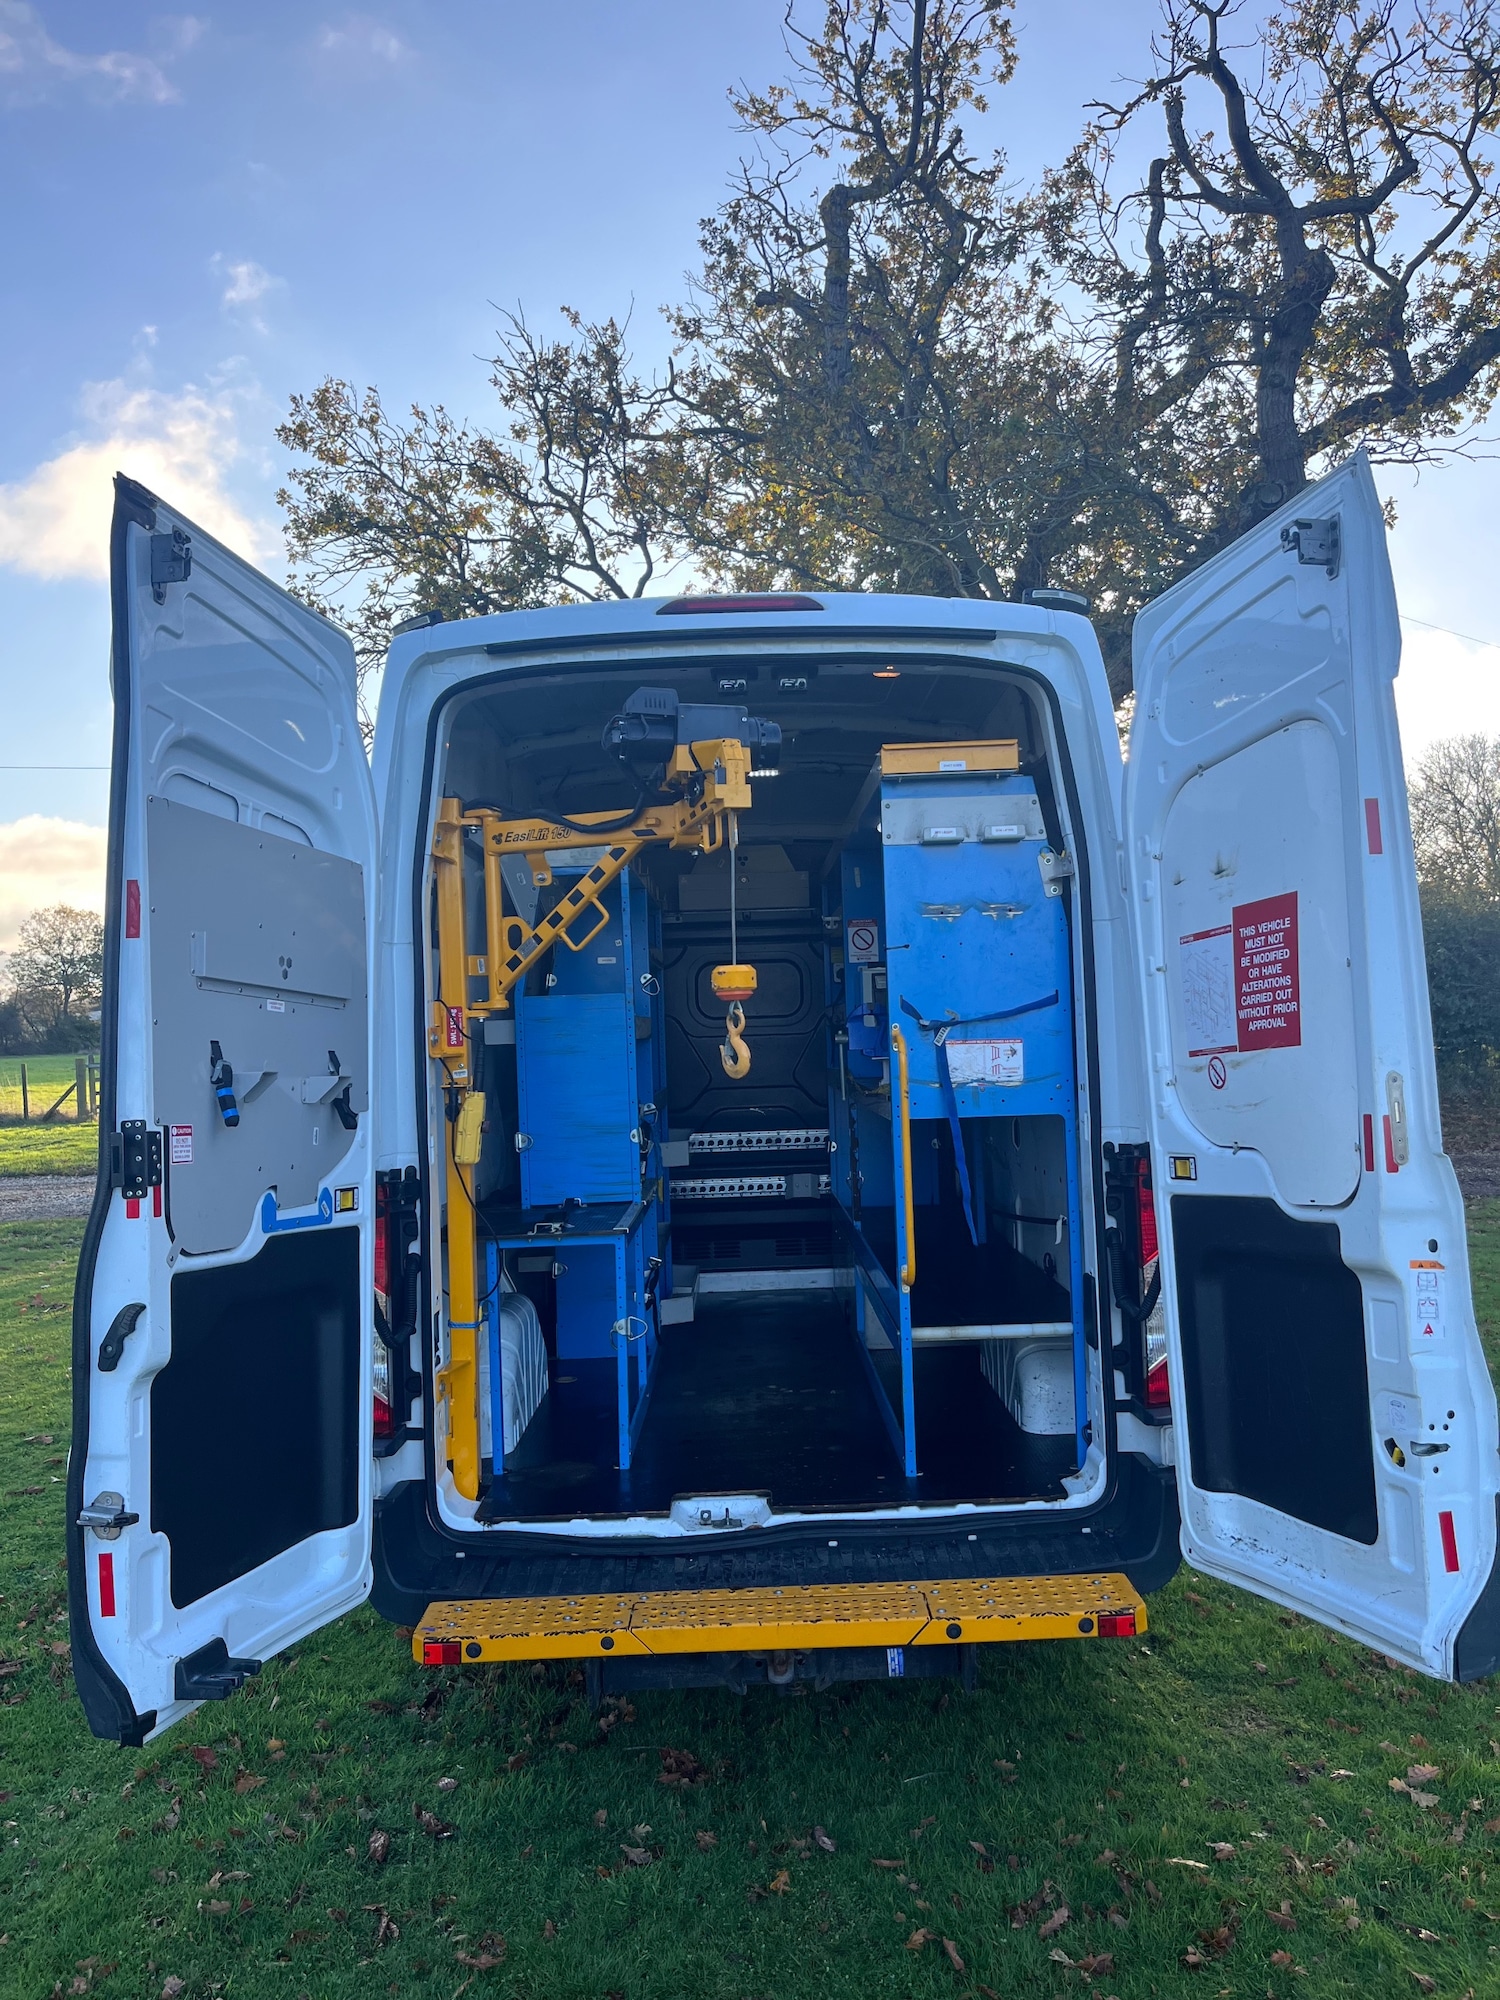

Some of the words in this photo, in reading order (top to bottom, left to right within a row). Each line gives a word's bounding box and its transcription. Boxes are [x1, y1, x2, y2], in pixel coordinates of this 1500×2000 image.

[504, 827, 550, 843] EasiLift
[551, 826, 572, 840] 150
[1239, 925, 1256, 938] THIS
[1257, 917, 1291, 933] VEHICLE
[1244, 936, 1266, 950] MUST
[1267, 932, 1284, 945] NOT
[1240, 956, 1251, 967] BE
[1252, 948, 1290, 965] MODIFIED
[1248, 967, 1260, 978] OR
[1261, 963, 1282, 976] HAVE
[1241, 975, 1292, 993] ALTERATIONS
[1241, 992, 1273, 1006] CARRIED
[1275, 988, 1293, 1000] OUT
[1237, 1005, 1271, 1019] WITHOUT
[1272, 1001, 1298, 1014] PRIOR
[1248, 1016, 1287, 1031] APPROVAL
